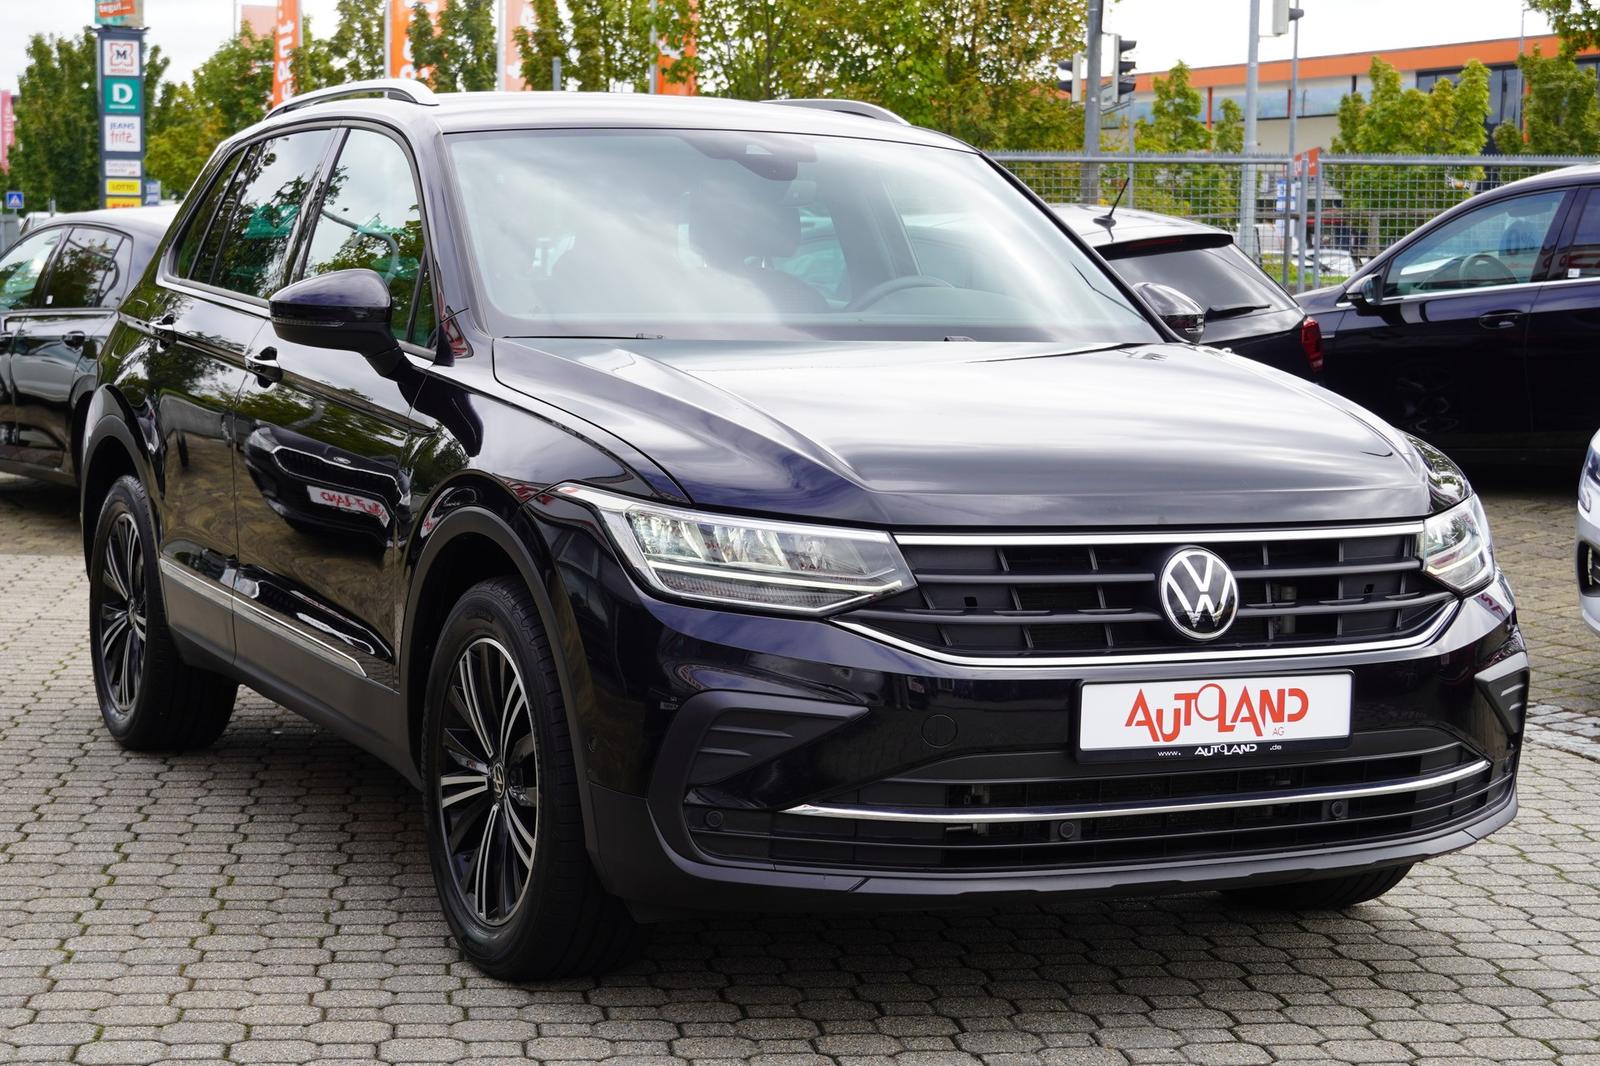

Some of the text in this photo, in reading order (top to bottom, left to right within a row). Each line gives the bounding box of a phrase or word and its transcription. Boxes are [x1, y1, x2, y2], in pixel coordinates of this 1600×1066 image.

[116, 50, 127, 60] M
[112, 83, 133, 103] D
[1125, 683, 1309, 742] AUTOLAND
[1272, 726, 1285, 736] AG
